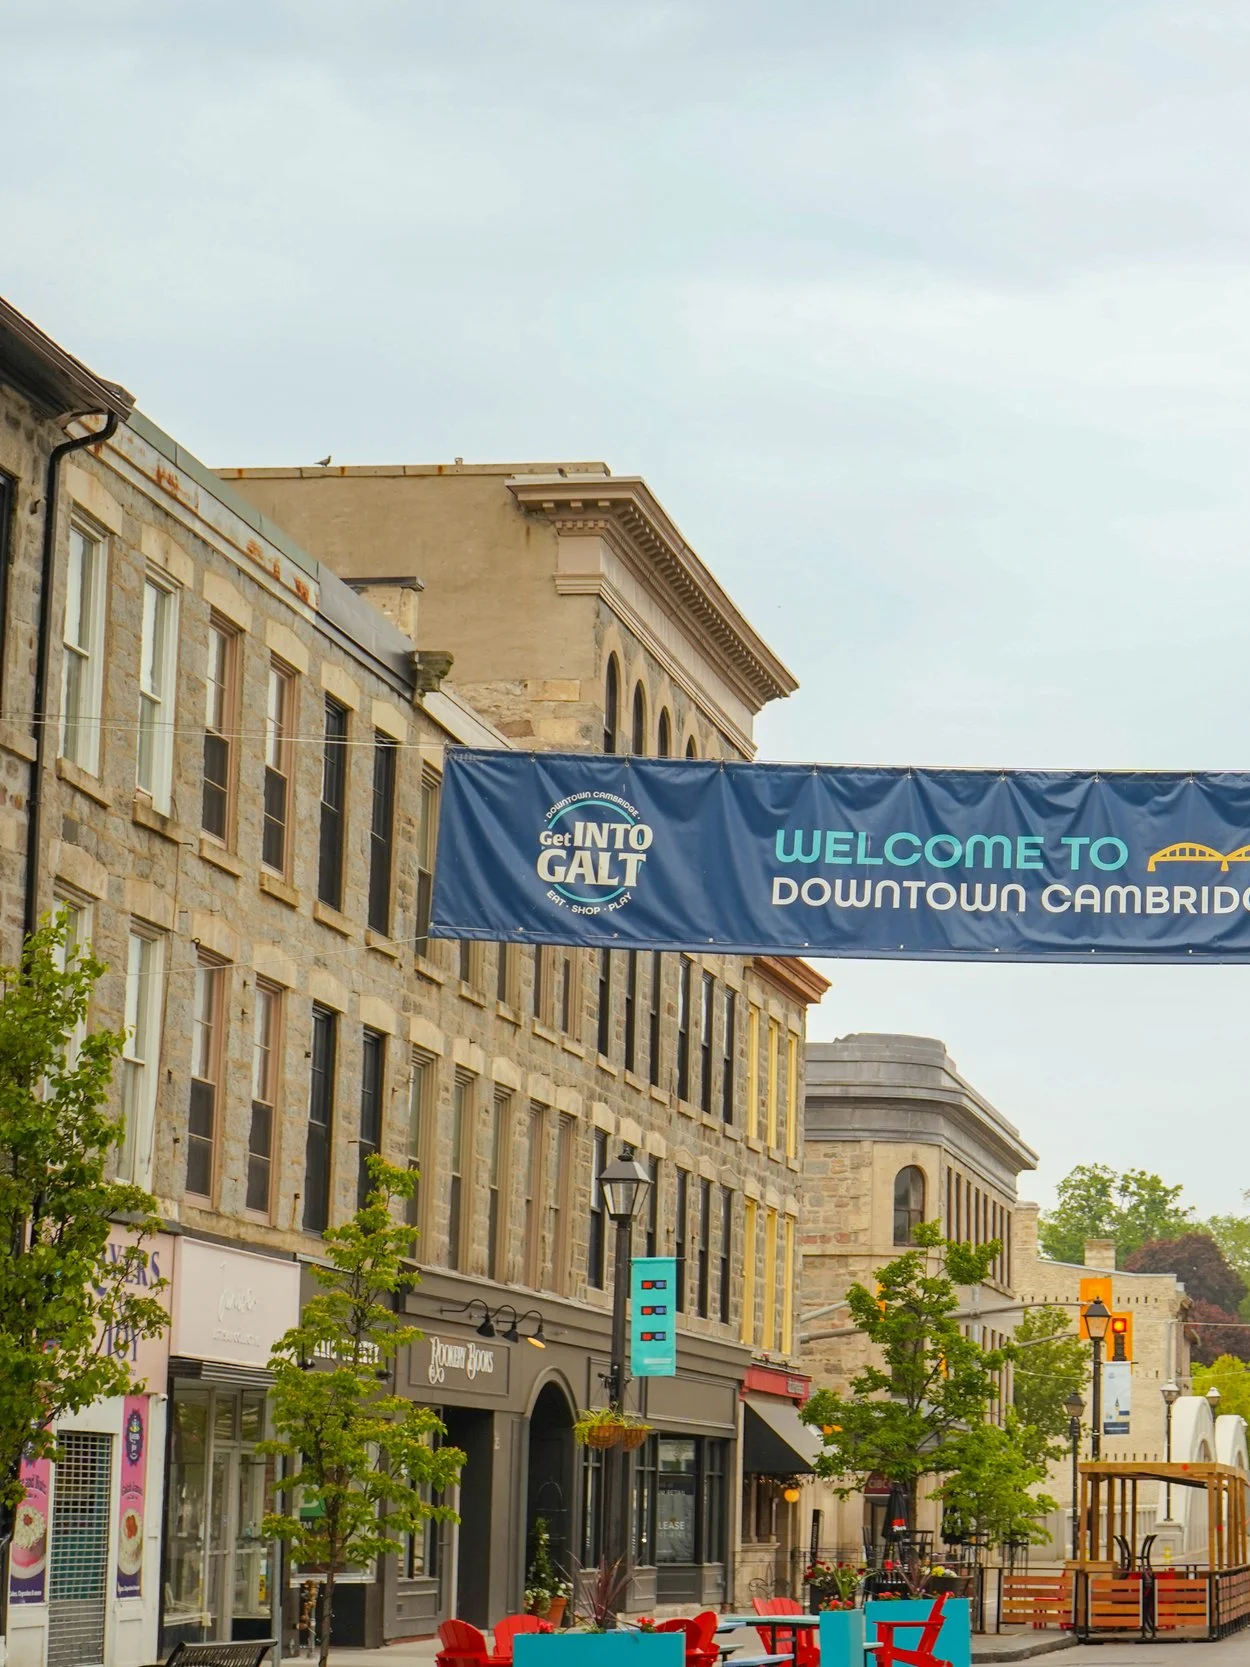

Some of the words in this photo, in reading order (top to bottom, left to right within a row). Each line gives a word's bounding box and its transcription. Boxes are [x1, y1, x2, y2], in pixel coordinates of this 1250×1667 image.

[546, 791, 592, 819] DOWNTOWN
[592, 791, 639, 817] CAMBRIDGE
[539, 830, 572, 847] Get
[573, 821, 653, 851] INTO
[774, 829, 1045, 870] WELCOME
[1060, 836, 1129, 871] TO
[536, 848, 647, 887] GALT
[546, 890, 566, 907] EAT
[571, 904, 601, 915] SHOP
[608, 892, 632, 912] PLAY
[771, 876, 1027, 912] DOWNTOWN
[659, 1521, 685, 1530] LEASE
